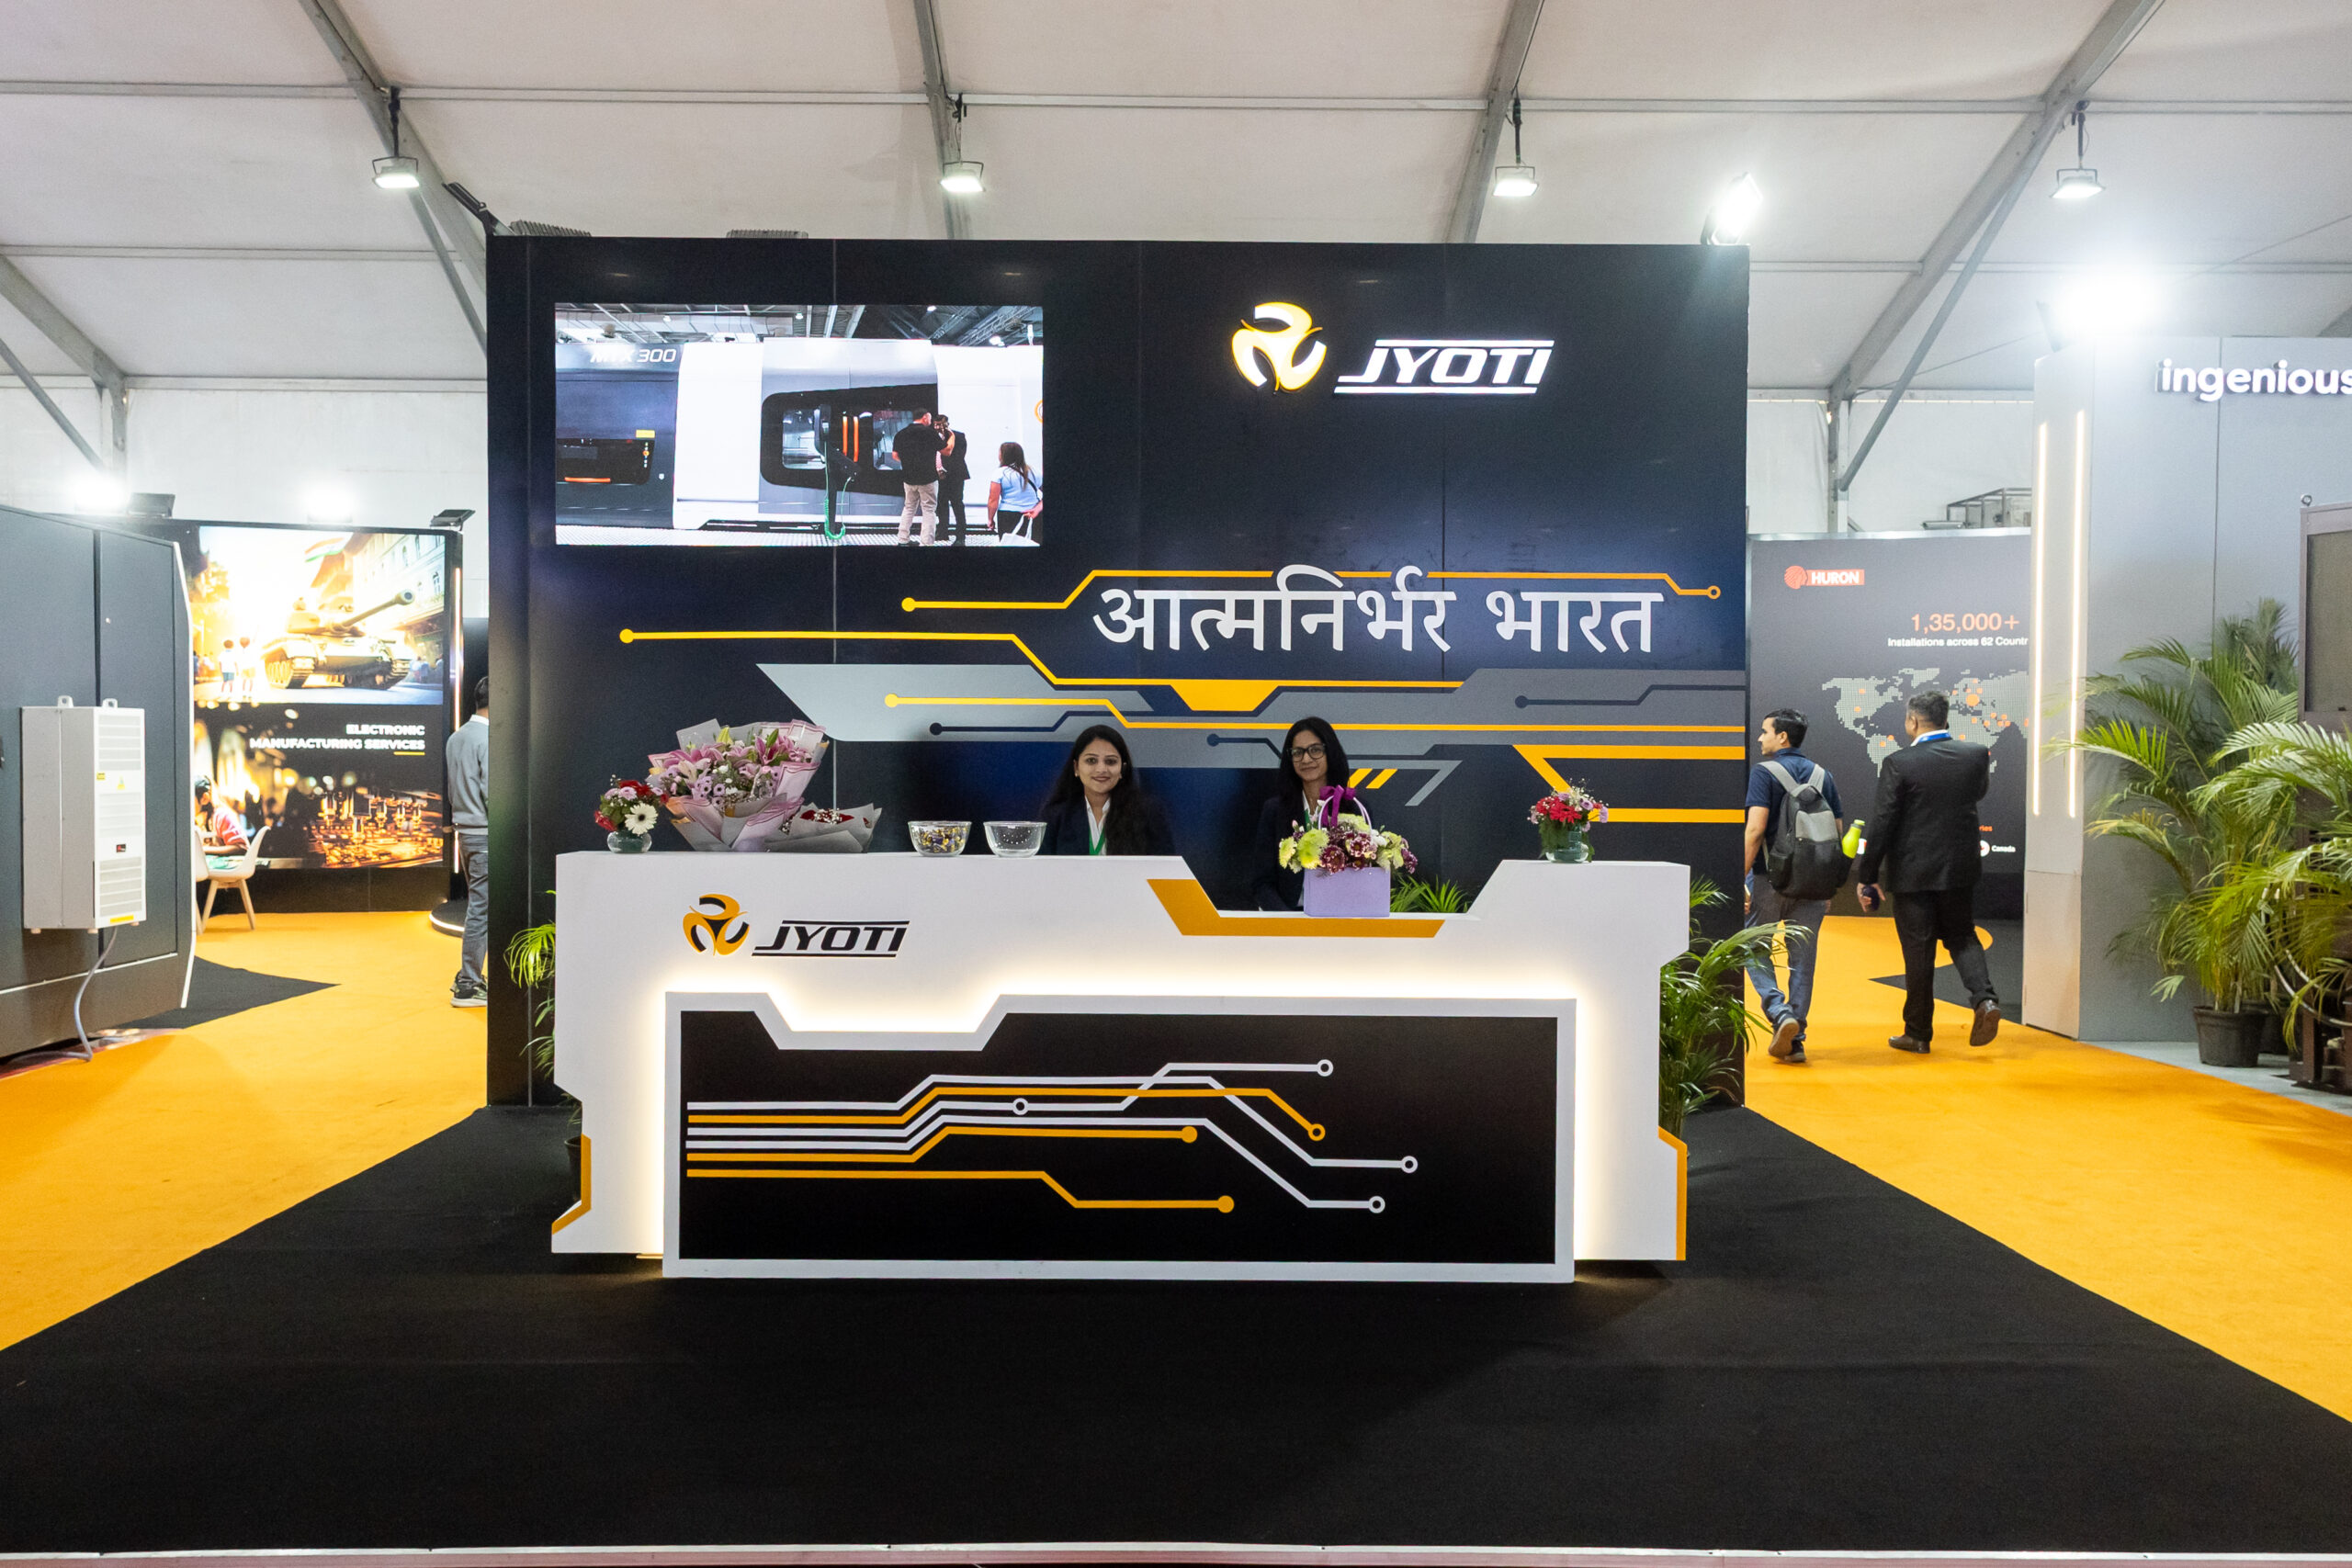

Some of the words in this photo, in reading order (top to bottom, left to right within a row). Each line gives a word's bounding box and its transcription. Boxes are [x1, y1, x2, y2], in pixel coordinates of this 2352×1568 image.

[590, 349, 634, 363] MX
[637, 348, 677, 363] 300
[1337, 346, 1554, 385] JYOTI
[2162, 357, 2352, 402] ingenious
[1811, 570, 1860, 585] HURON
[1091, 564, 1456, 652] आत्मनिर्भर
[1486, 590, 1665, 652] भारत
[1910, 612, 2020, 634] 1,35,000+
[1887, 637, 1945, 648] Installations
[1946, 637, 1980, 647] across
[1980, 636, 1994, 647] 62
[345, 723, 426, 736] ELECTRONIC
[249, 737, 363, 750] MANUFACTURING
[364, 738, 426, 750] SERVICES
[1991, 844, 2017, 853] Canada
[753, 925, 908, 953] JYOTI
